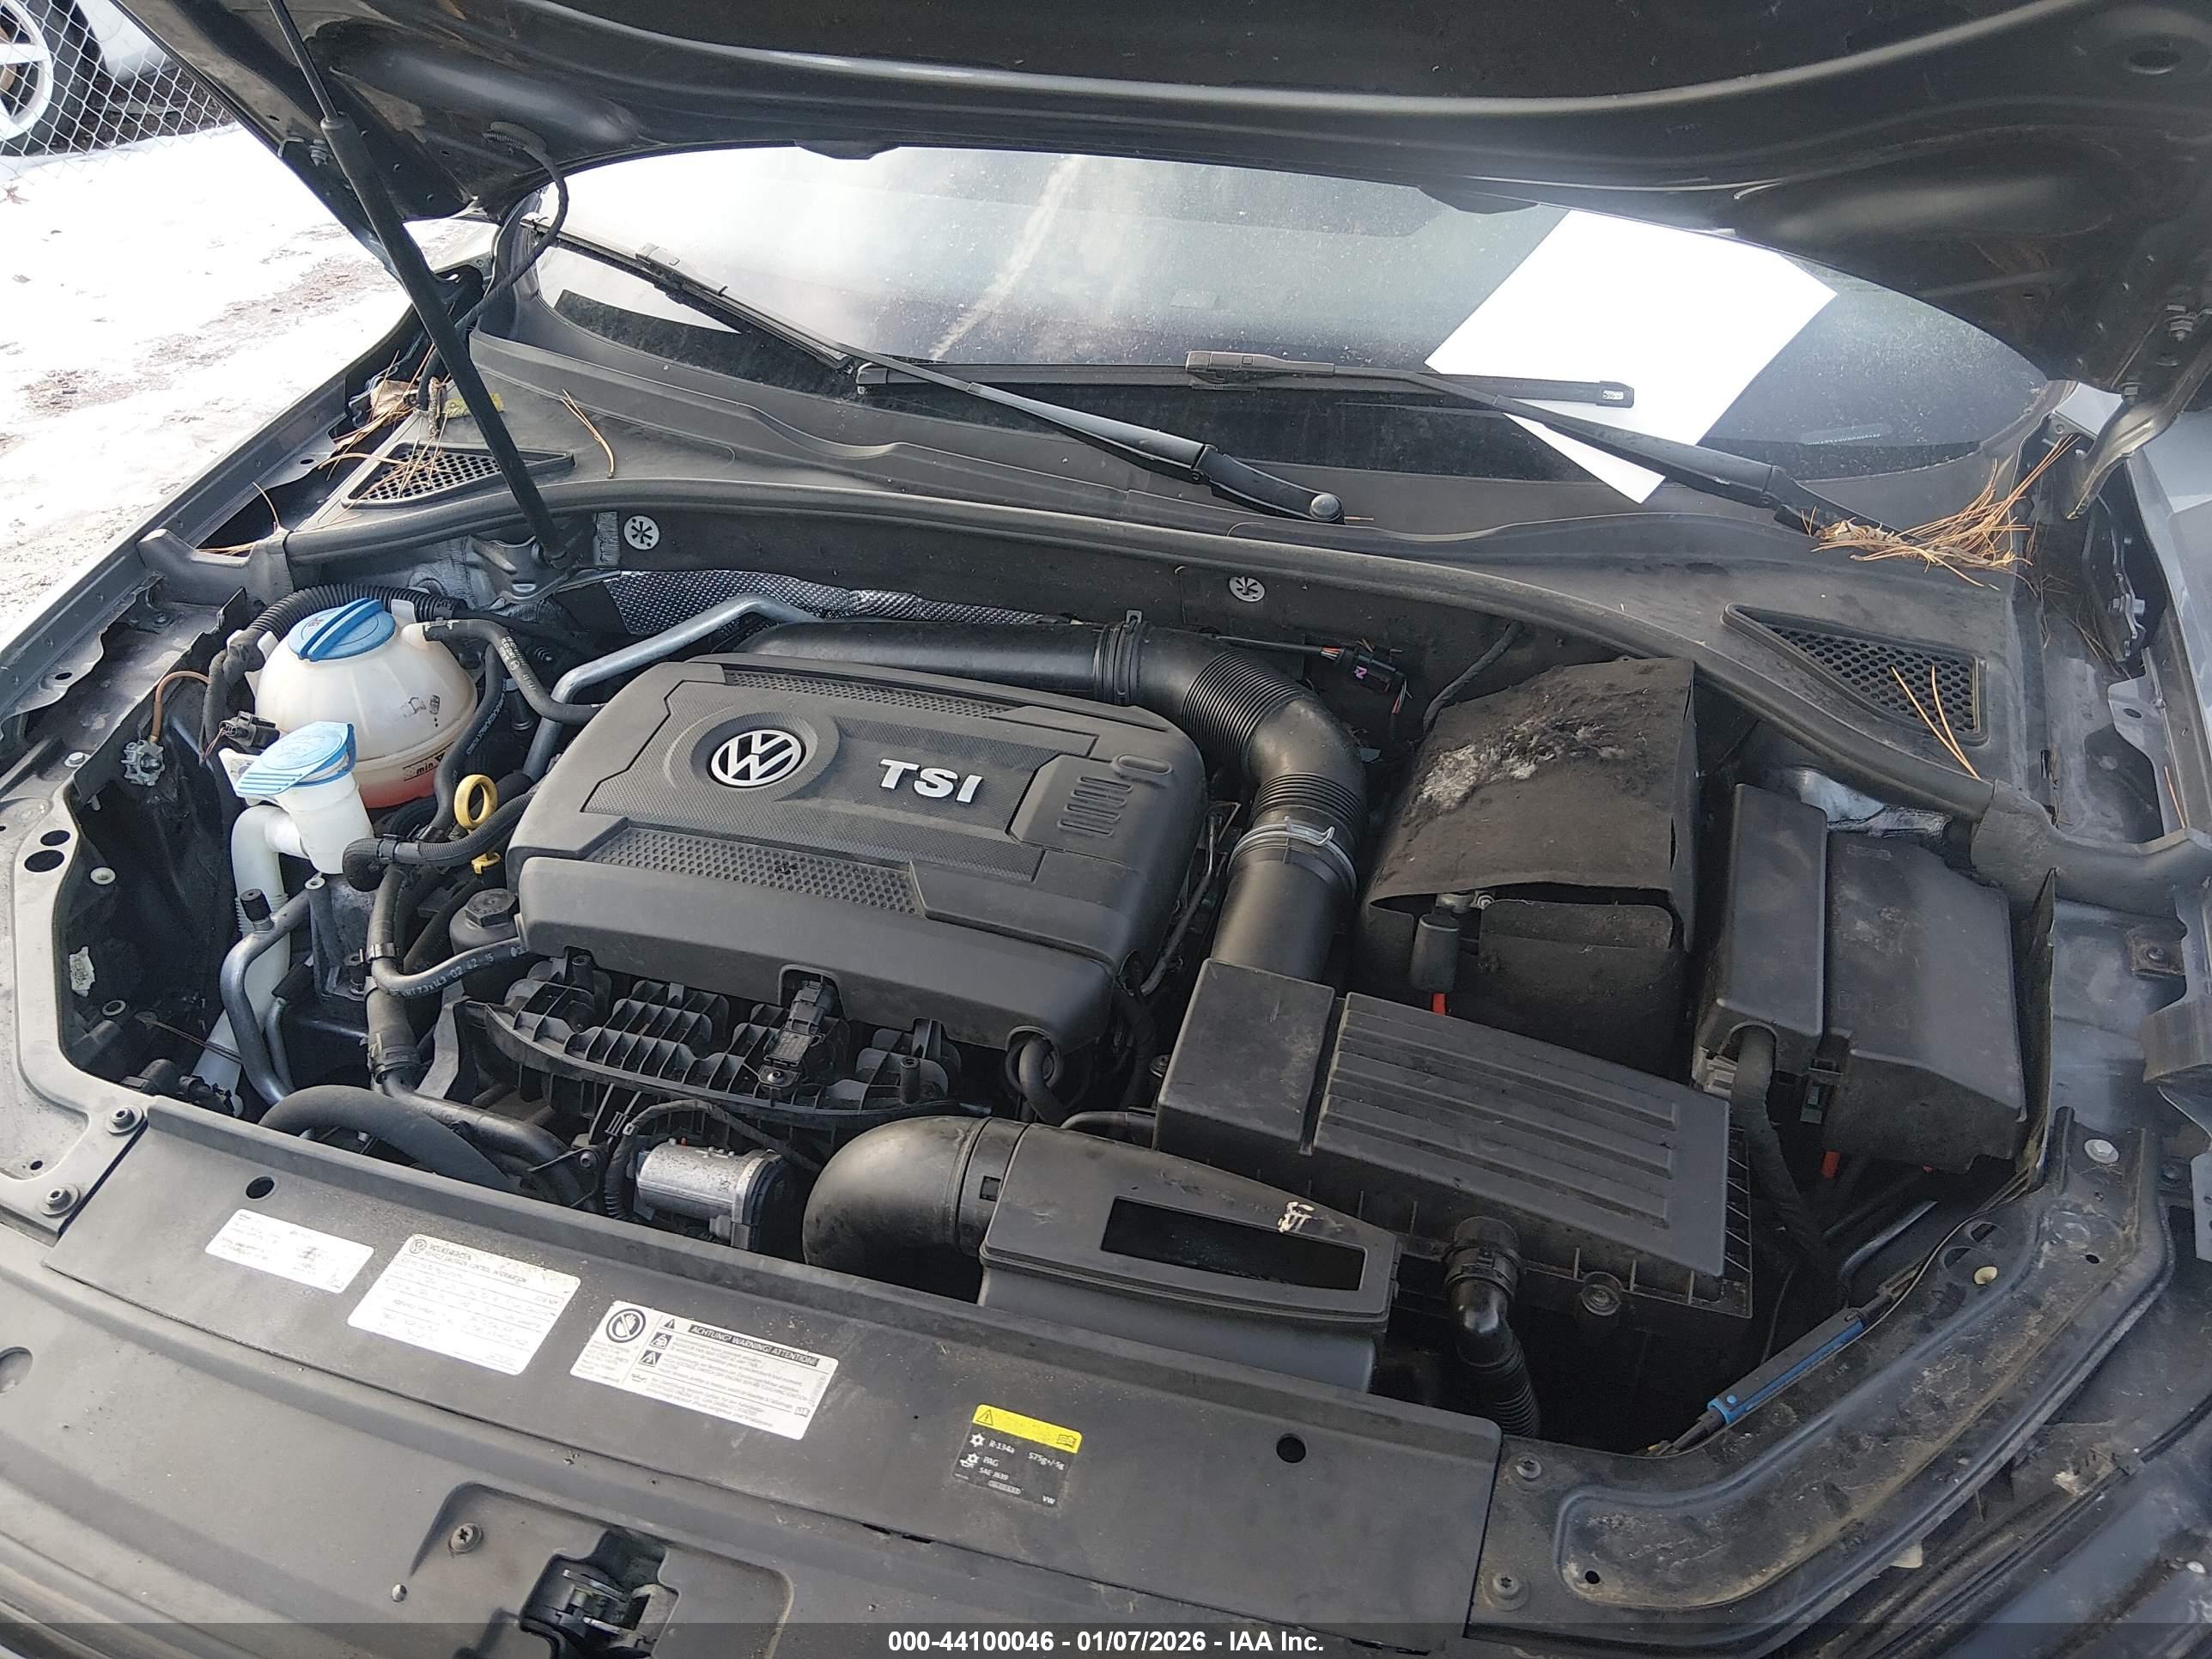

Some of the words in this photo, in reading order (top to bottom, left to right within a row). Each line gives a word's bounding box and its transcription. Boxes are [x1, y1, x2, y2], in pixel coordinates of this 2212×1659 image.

[416, 763, 434, 775] min
[879, 758, 984, 803] TSI
[690, 1326, 731, 1342] ACHTUNG!
[732, 1336, 772, 1353] WARNING!
[772, 1347, 817, 1366] ATTENTION!
[988, 1439, 1016, 1455] R-134a
[982, 1455, 1000, 1468] PAG
[1042, 1495, 1056, 1504] VW
